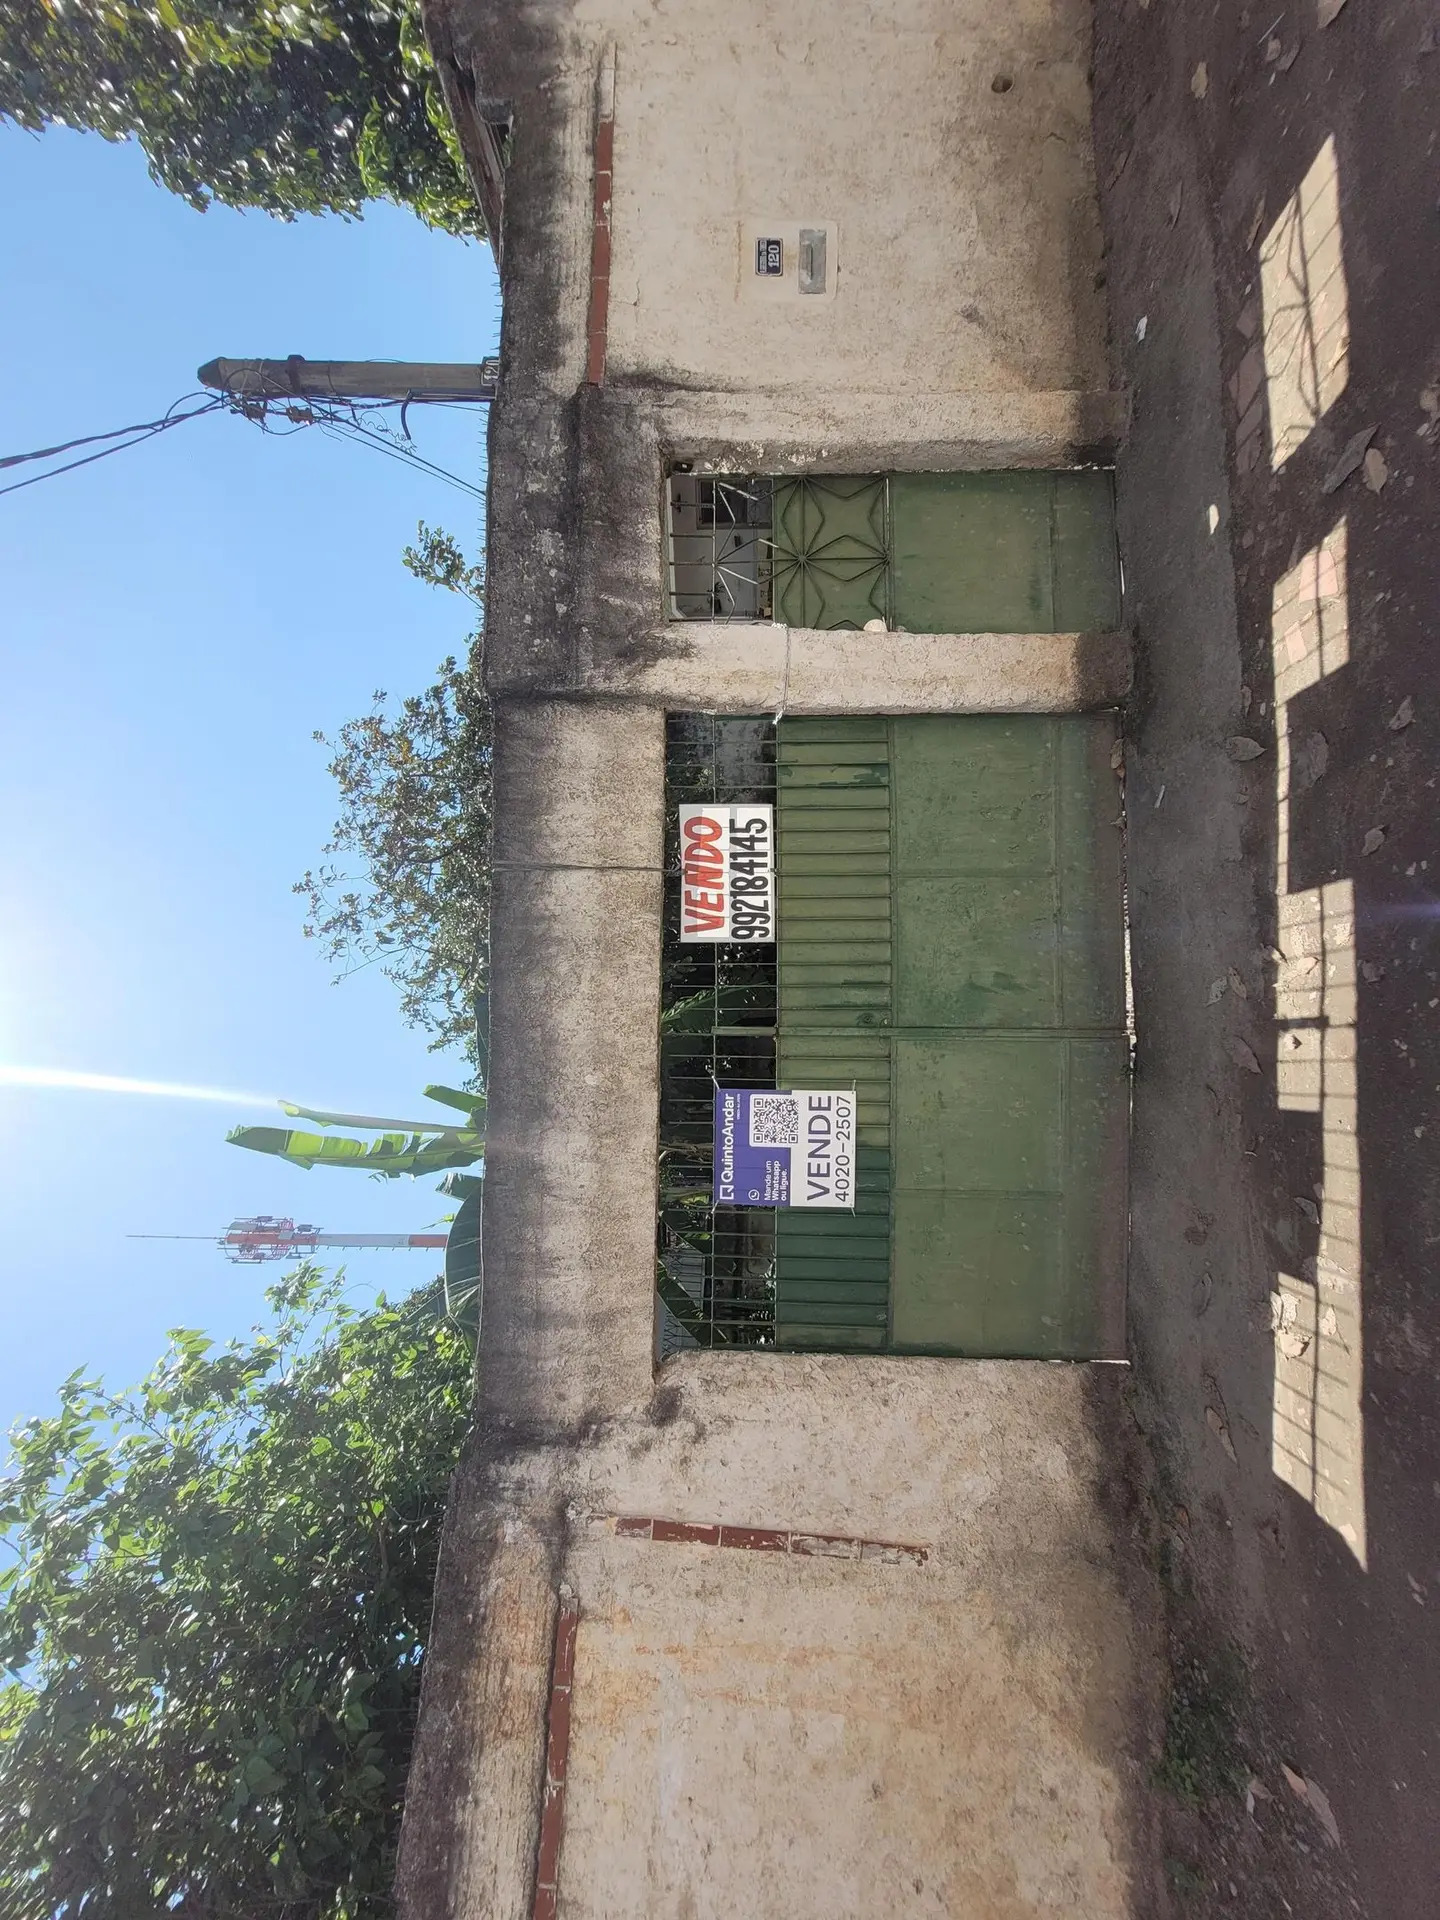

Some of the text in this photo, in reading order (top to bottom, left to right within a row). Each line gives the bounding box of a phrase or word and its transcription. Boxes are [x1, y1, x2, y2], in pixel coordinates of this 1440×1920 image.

[768, 245, 780, 267] 120
[684, 816, 725, 934] VENDO
[730, 818, 771, 940] 992184145
[721, 1093, 735, 1183] QuintoAndar
[764, 1160, 772, 1201] Mande um
[772, 1160, 781, 1201] Whatsapp
[807, 1095, 832, 1201] VENDE
[834, 1095, 851, 1202] 4020-2507
[780, 1168, 788, 1202] ou ligue.
